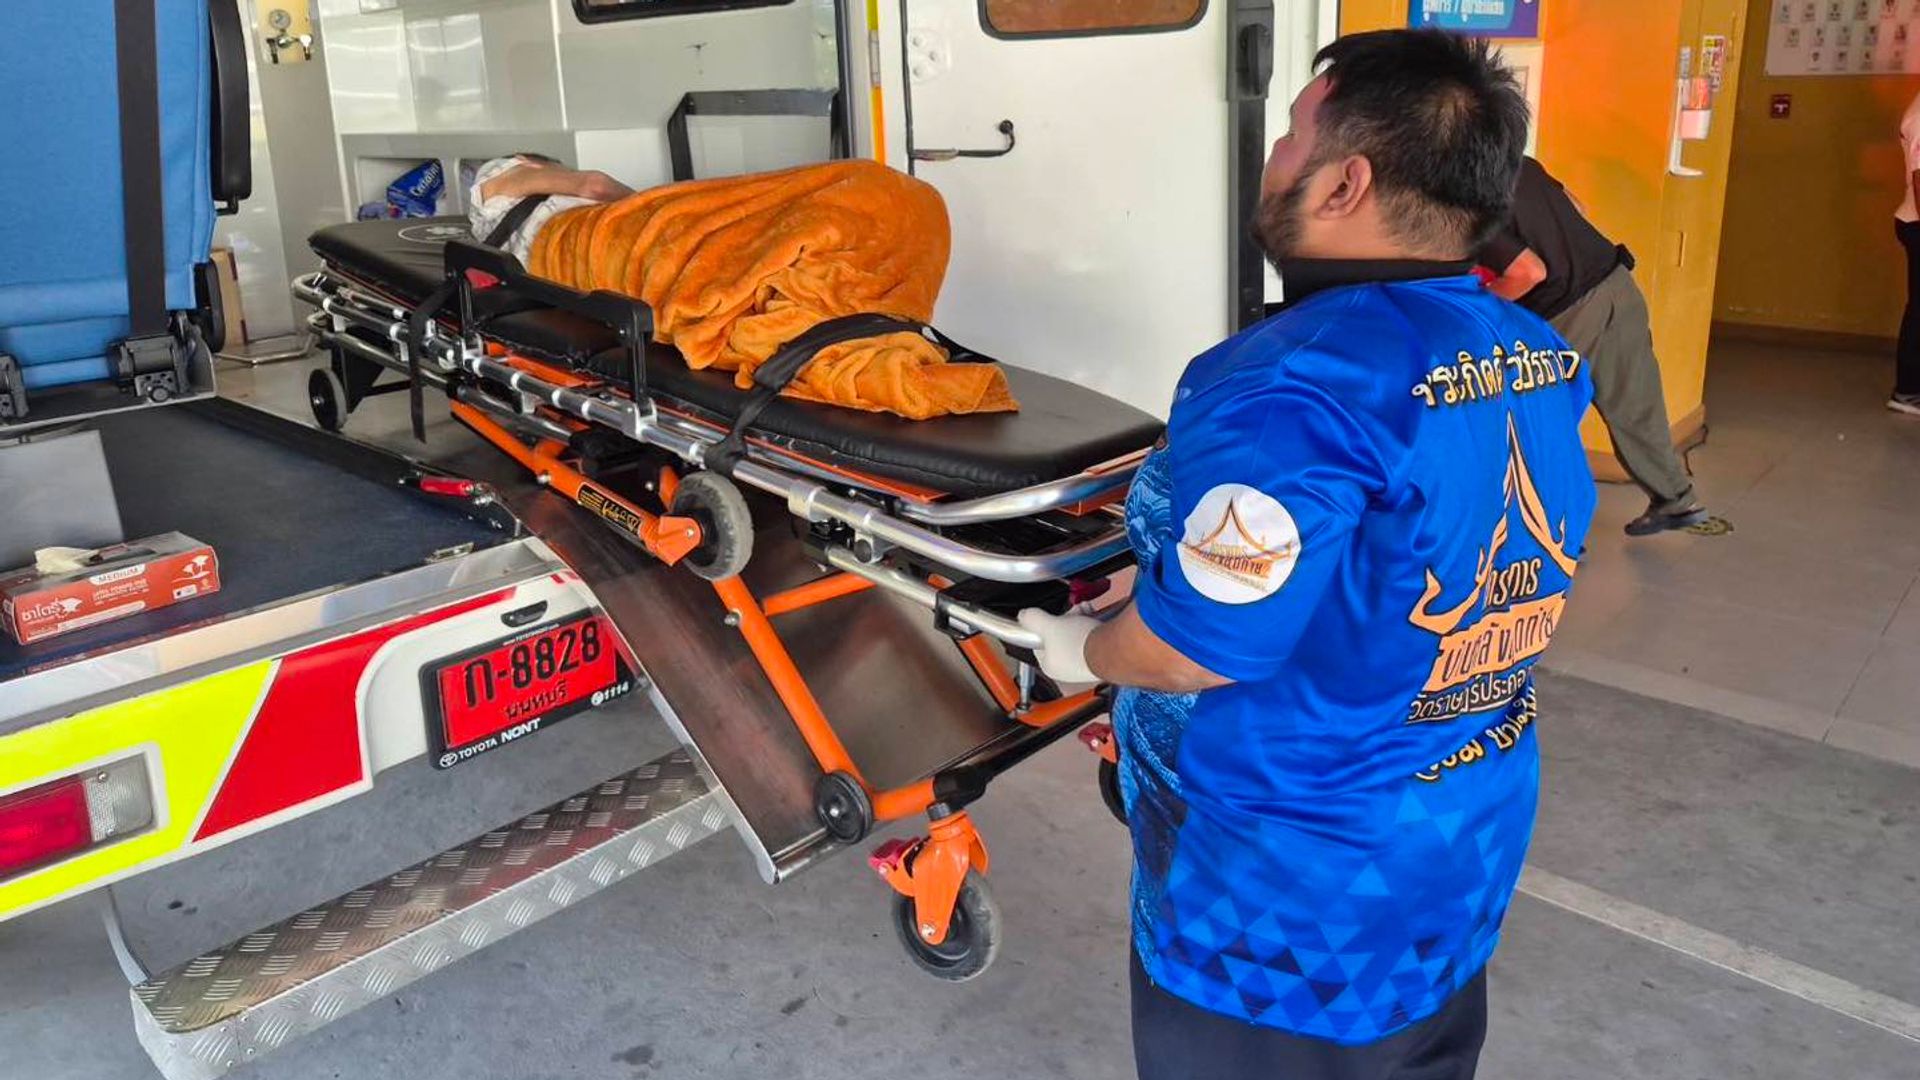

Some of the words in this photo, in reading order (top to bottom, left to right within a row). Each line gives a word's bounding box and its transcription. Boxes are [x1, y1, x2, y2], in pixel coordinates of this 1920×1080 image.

[457, 738, 498, 760] TOYOTA
[500, 717, 541, 744] NONT
[602, 681, 630, 700] 1114
